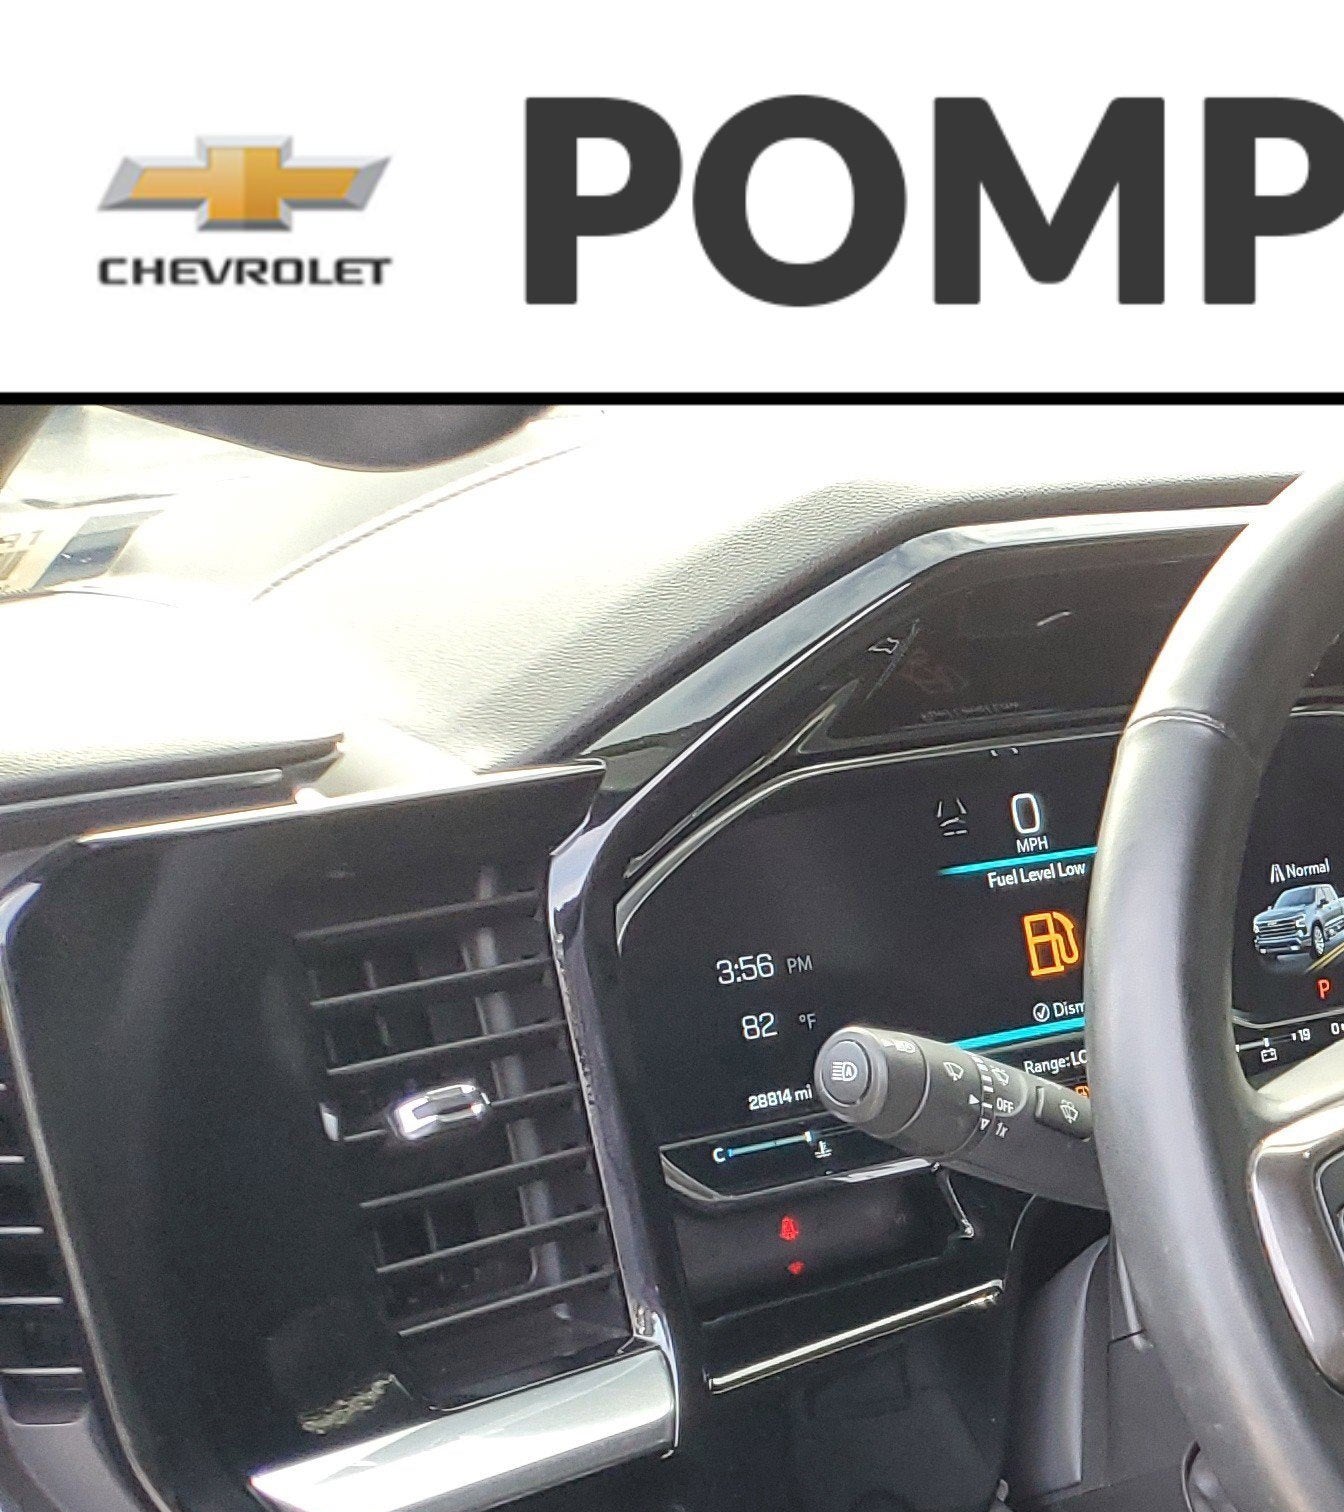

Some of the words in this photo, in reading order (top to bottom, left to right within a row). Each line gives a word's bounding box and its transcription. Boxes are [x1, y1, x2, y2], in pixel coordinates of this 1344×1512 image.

[1010, 792, 1041, 834] 0
[1015, 835, 1049, 854] MPH
[986, 868, 1019, 889] Fuel
[1019, 862, 1056, 884] Level
[1058, 861, 1086, 878] Low
[1286, 857, 1331, 880] Normal
[716, 953, 775, 985] 3:56
[786, 955, 814, 975] PM
[1316, 978, 1331, 1000] P
[741, 1012, 779, 1041] 82
[1298, 1028, 1311, 1043] 19
[748, 1087, 793, 1111] 28814
[793, 1083, 814, 1101] mi
[995, 1097, 1015, 1115] OFF
[995, 1122, 1009, 1139] 1x
[712, 1147, 726, 1163] C
